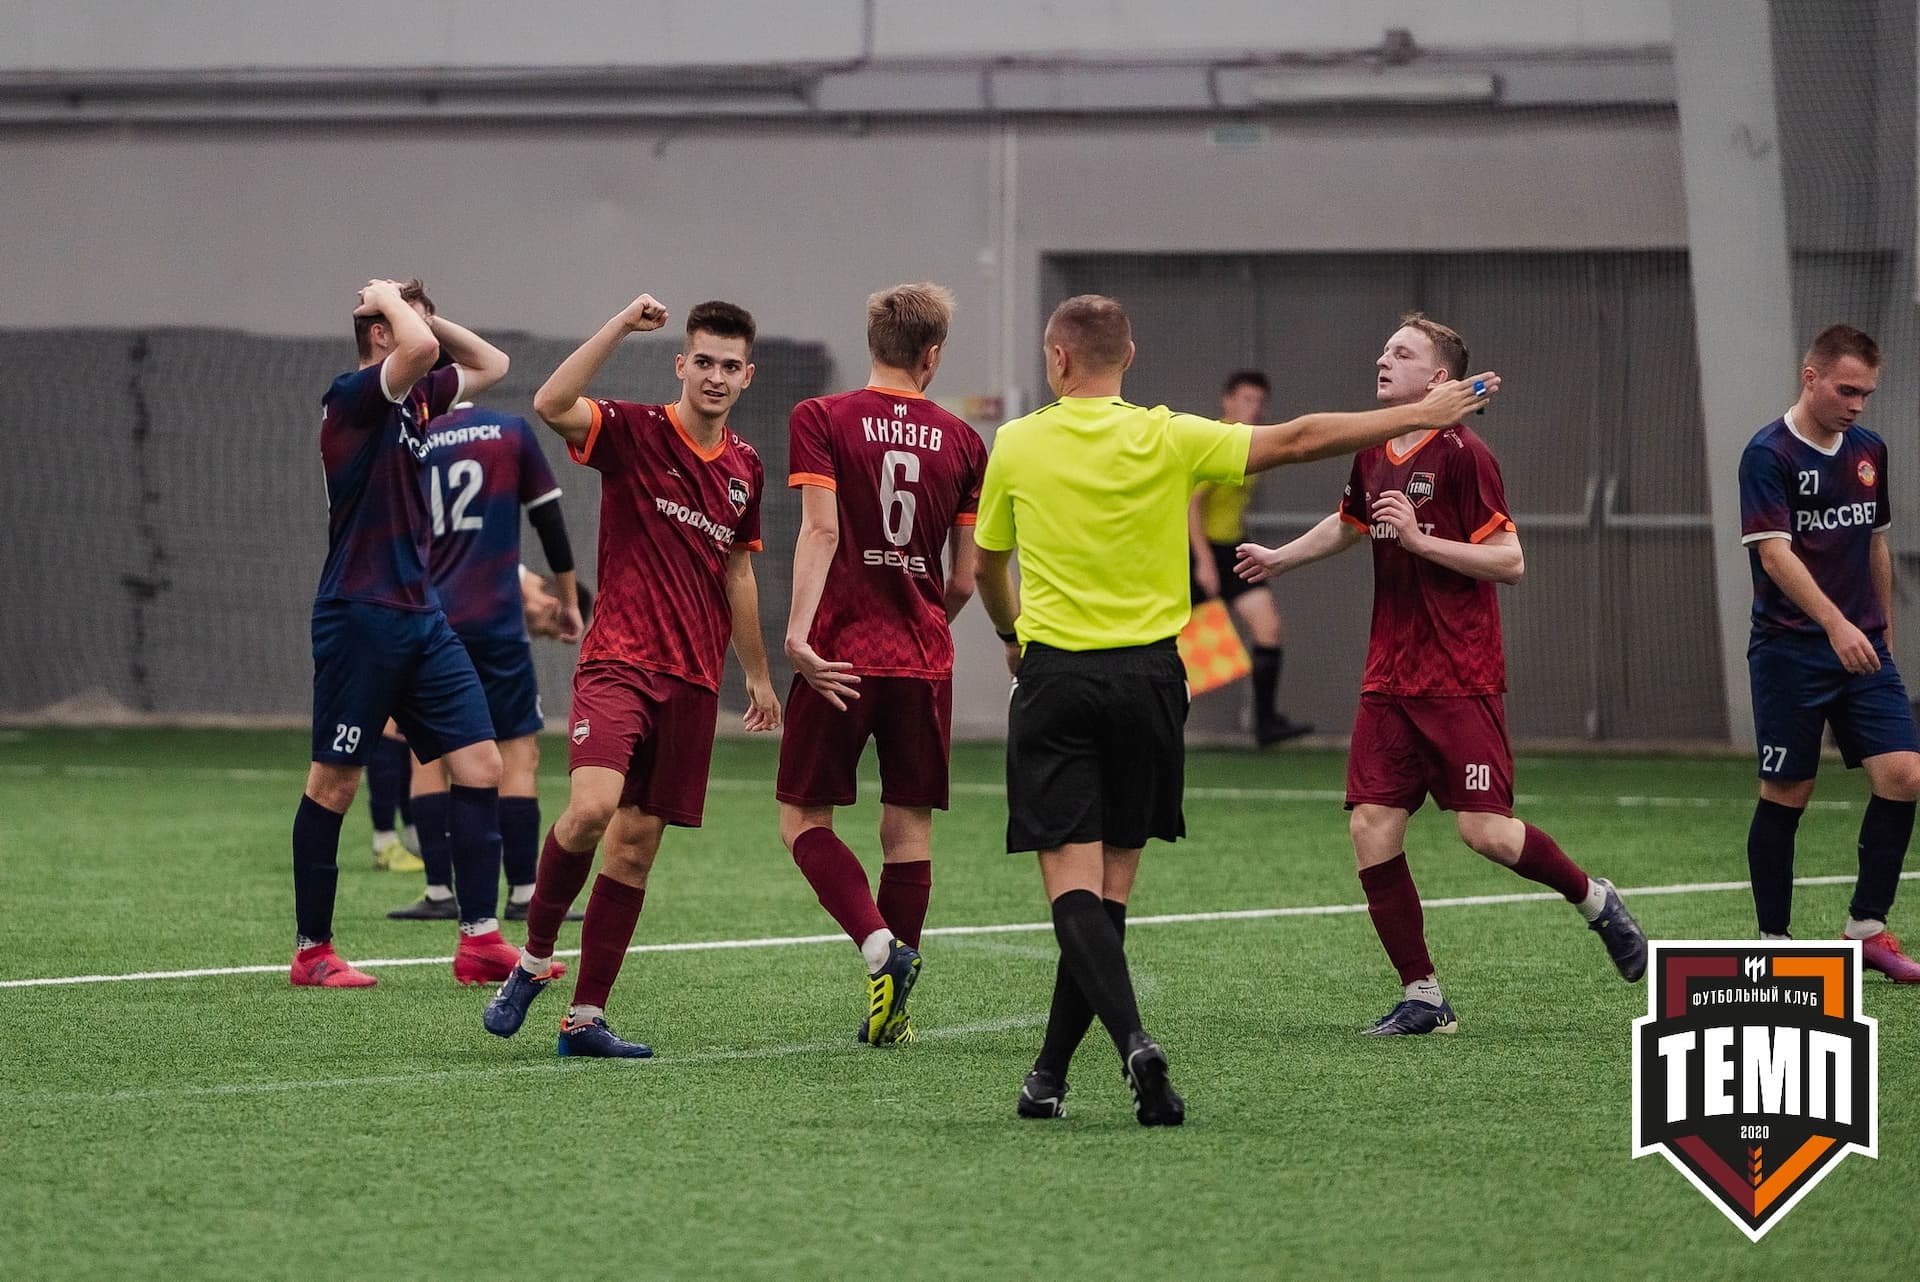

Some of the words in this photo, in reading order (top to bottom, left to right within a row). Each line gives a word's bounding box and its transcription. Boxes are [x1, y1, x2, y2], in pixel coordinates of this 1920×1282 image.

[427, 425, 502, 449] НОЯРСК
[862, 416, 943, 451] КНЯЗЕВ
[1798, 469, 1819, 495] 27
[431, 458, 485, 537] 12
[879, 449, 920, 547] 6
[332, 722, 362, 754] 29
[1762, 744, 1788, 773] 27
[1465, 763, 1490, 791] 20
